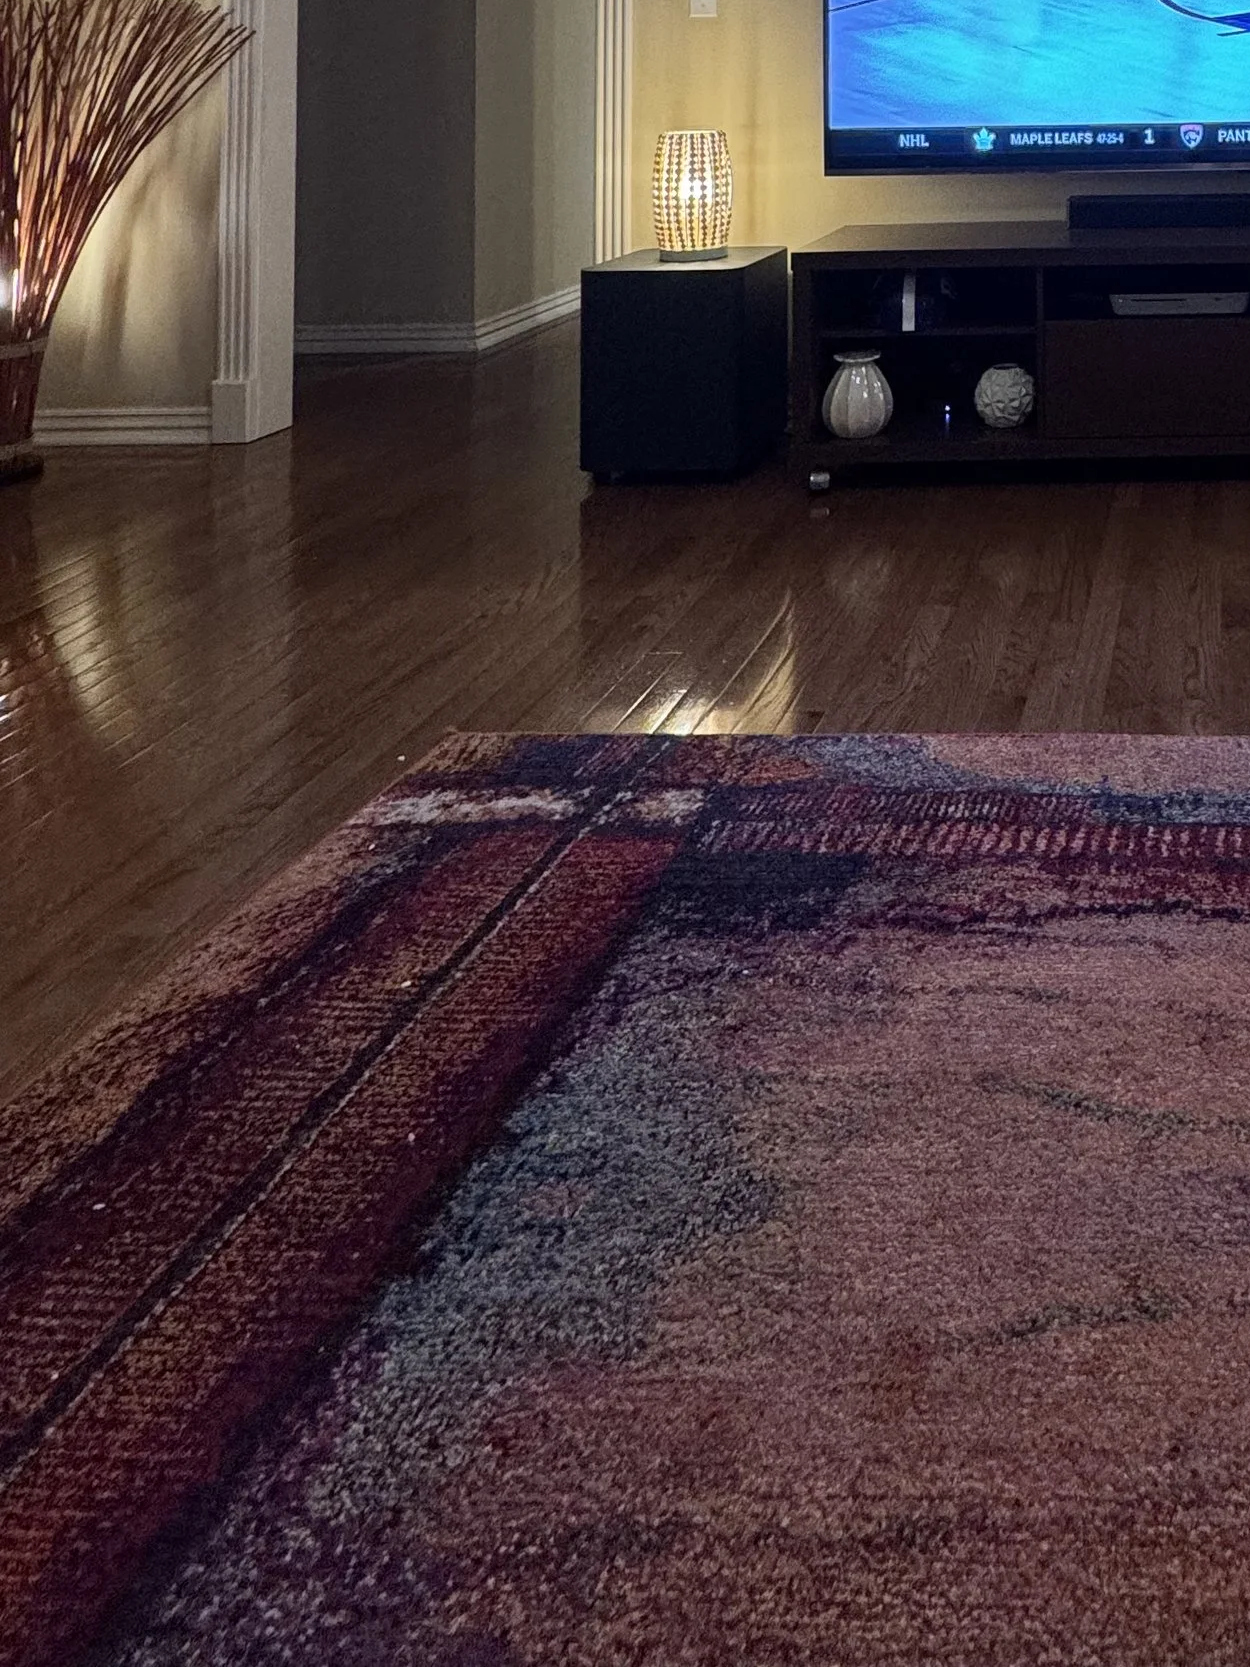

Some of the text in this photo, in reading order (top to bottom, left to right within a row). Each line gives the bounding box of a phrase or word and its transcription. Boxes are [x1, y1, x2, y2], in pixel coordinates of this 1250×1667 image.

[899, 133, 930, 148] NHL
[1010, 132, 1051, 146] MAPLE
[1054, 131, 1093, 145] LEAFS
[1144, 128, 1155, 145] 1
